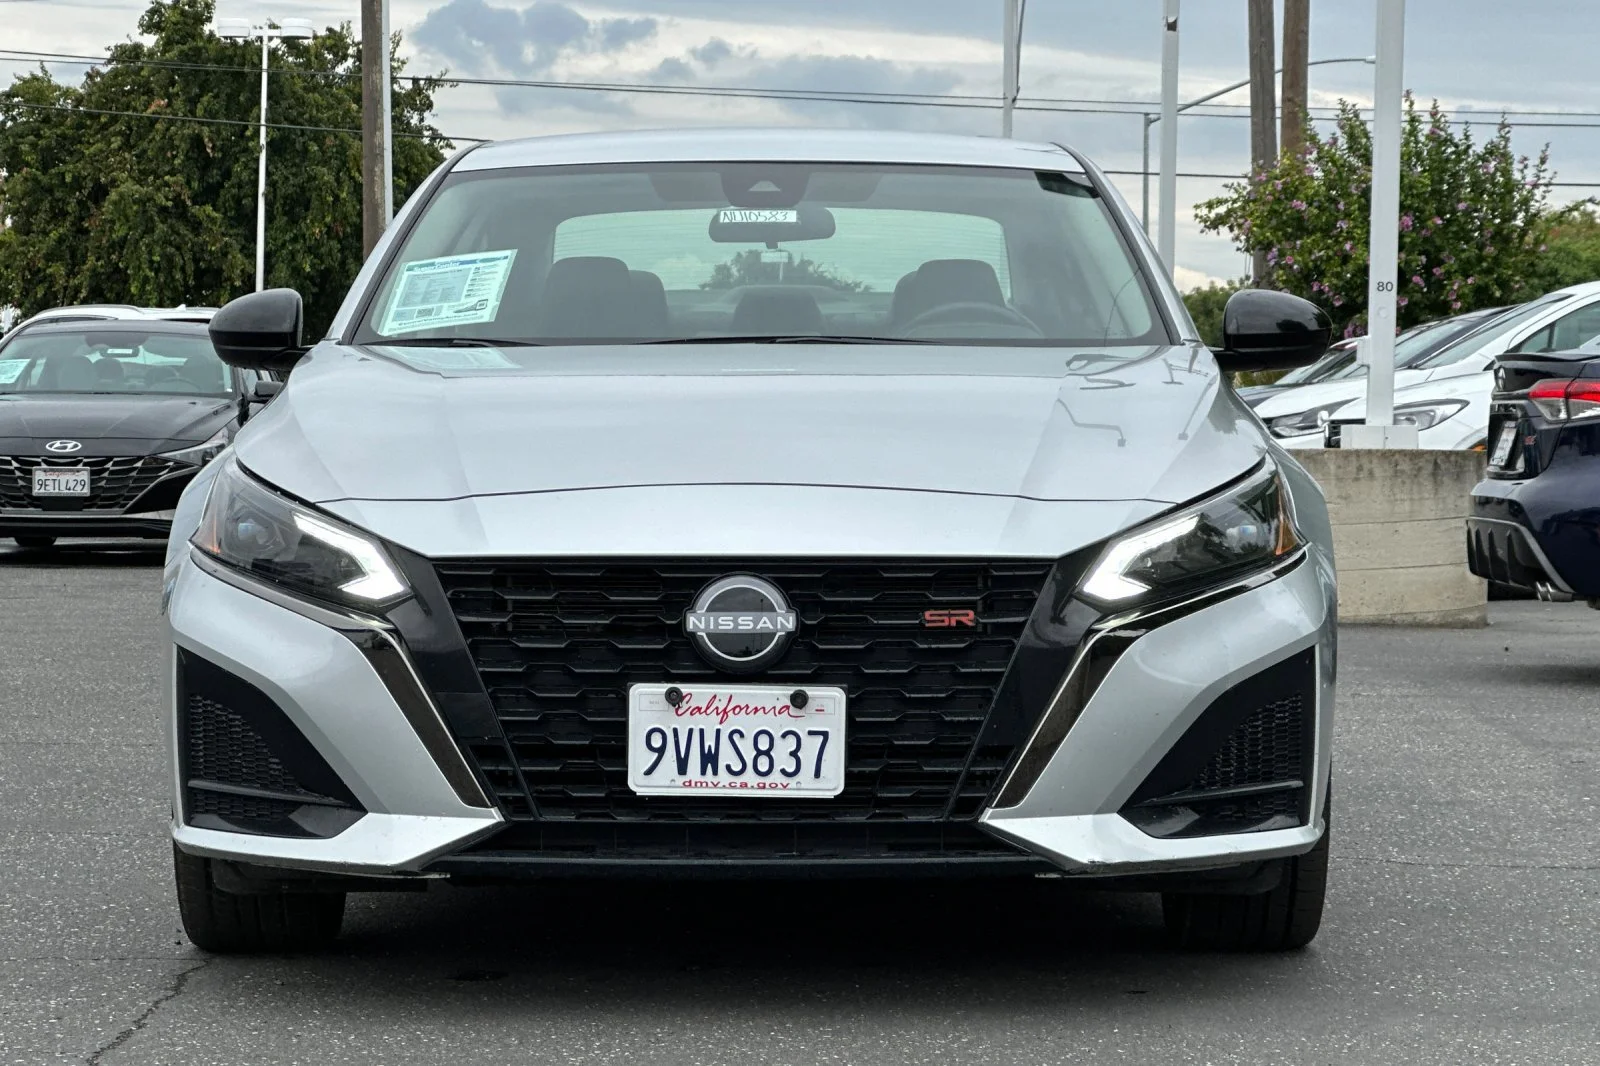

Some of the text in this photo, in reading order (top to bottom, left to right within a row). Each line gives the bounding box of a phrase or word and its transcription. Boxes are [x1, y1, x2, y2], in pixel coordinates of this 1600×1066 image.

[1376, 281, 1394, 292] 80
[36, 478, 87, 492] 9ETL429
[688, 615, 794, 630] NISSAN
[924, 609, 976, 628] SR
[674, 691, 806, 725] California
[642, 726, 830, 779] 9VWS837
[682, 778, 791, 790] dmv.ca.gov
